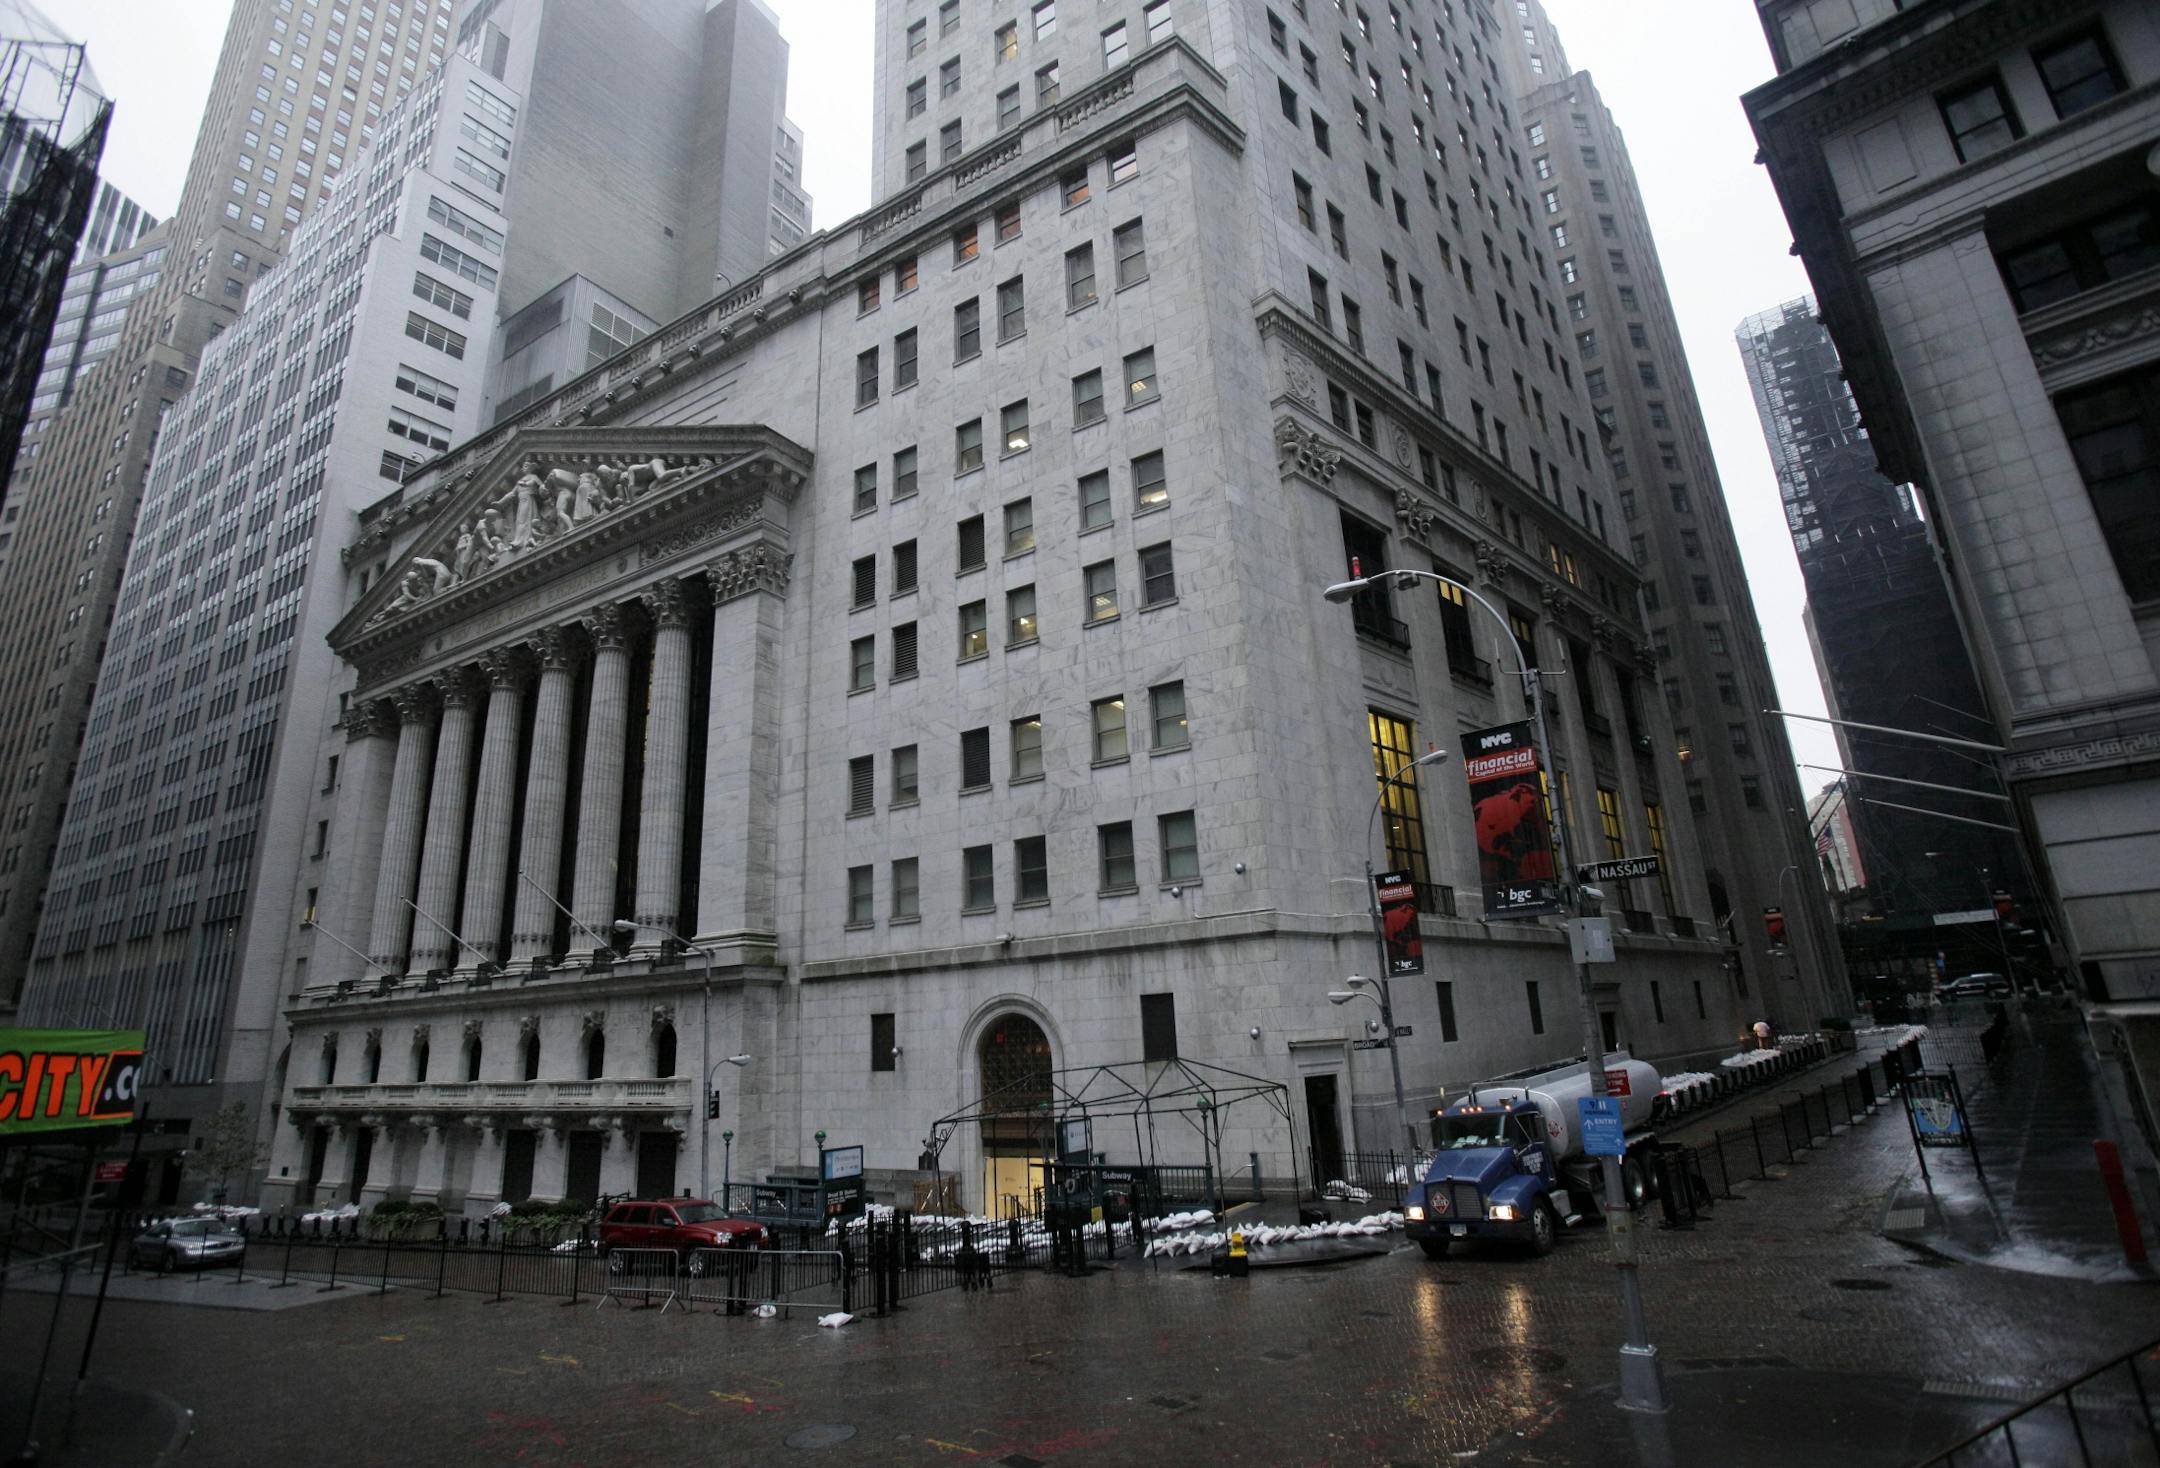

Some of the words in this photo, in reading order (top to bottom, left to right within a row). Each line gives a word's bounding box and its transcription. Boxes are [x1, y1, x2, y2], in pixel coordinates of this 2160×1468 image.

[1480, 732, 1512, 749] NYC
[1468, 748, 1533, 776] financial
[1600, 862, 1648, 878] NASSAU
[1647, 861, 1656, 869] ST
[1384, 875, 1401, 884] NYC
[1379, 884, 1412, 899] financial
[1509, 888, 1532, 902] bgc
[1354, 1041, 1375, 1049] BROAD
[1102, 1171, 1132, 1182] Subway
[756, 1188, 776, 1198] Subway
